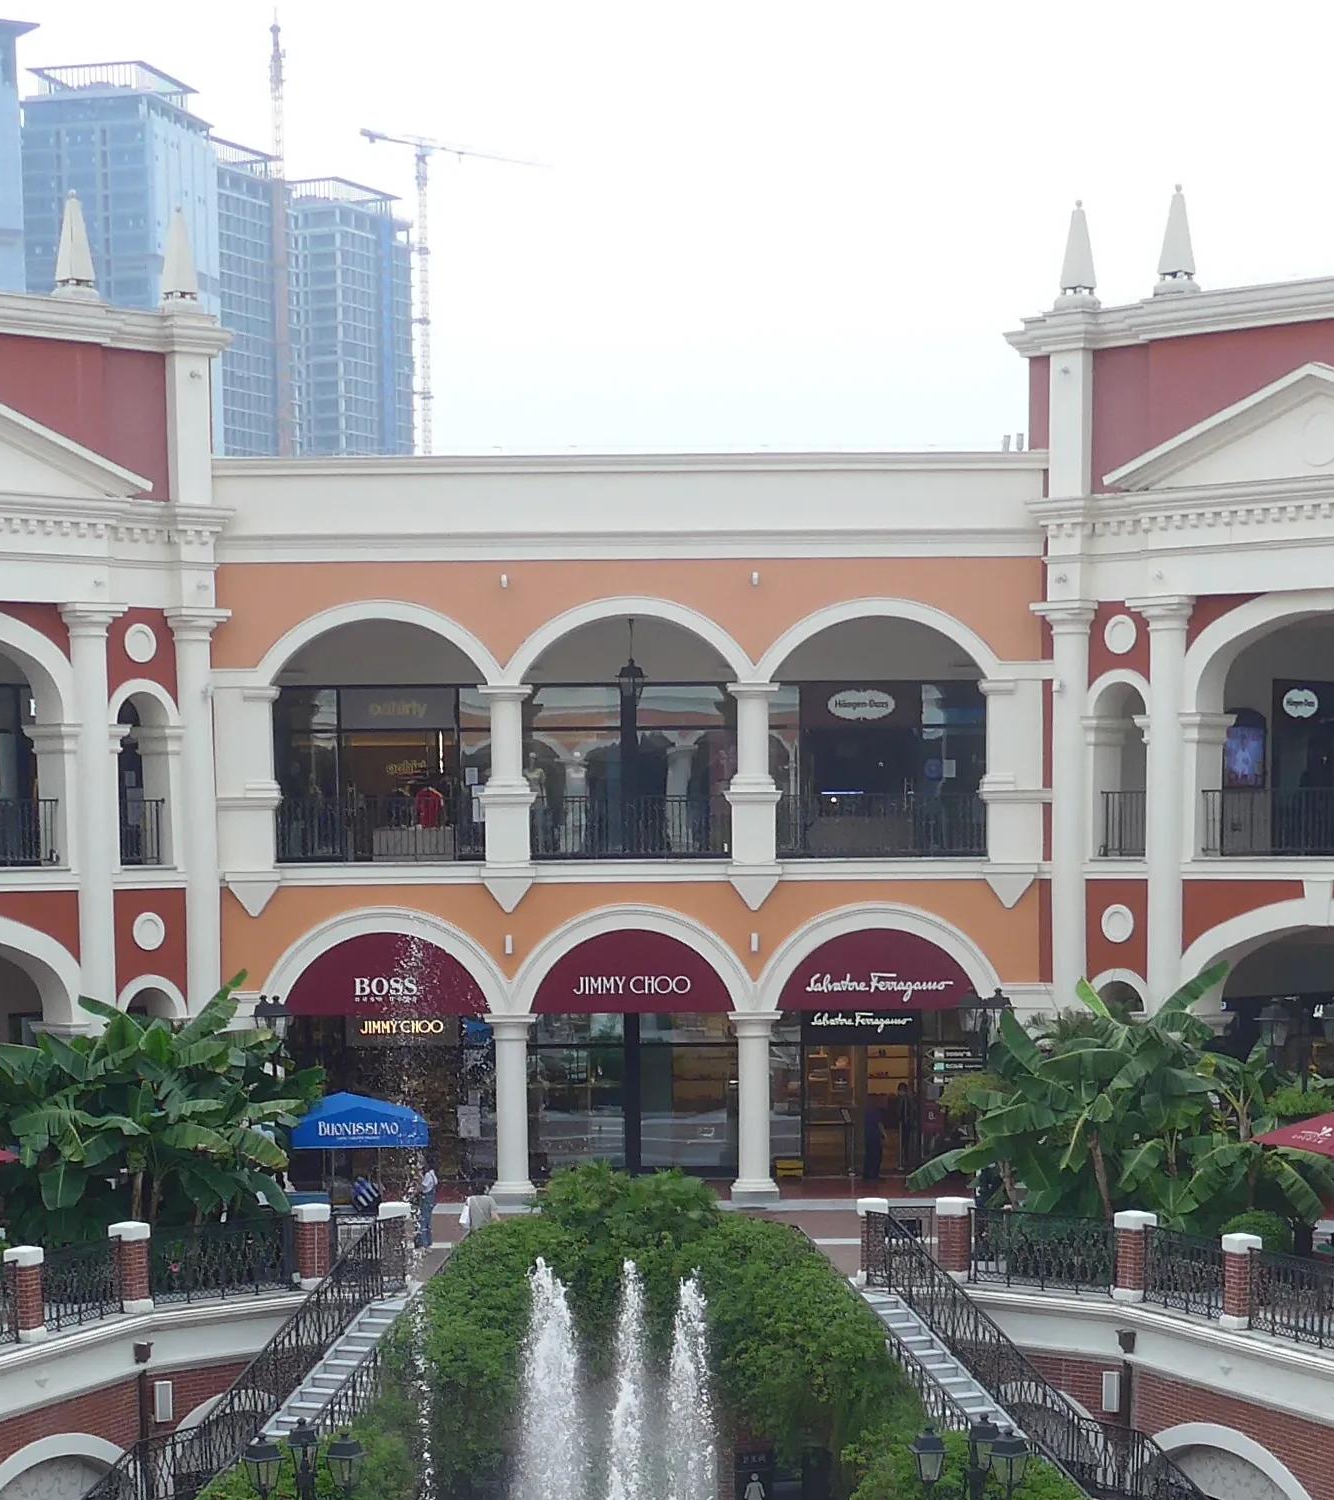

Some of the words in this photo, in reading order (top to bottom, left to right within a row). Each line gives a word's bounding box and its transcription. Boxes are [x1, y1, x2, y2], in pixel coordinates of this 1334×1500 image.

[354, 977, 419, 996] BOSS
[573, 976, 627, 995] JIMMY
[630, 975, 691, 995] CHOO
[805, 973, 869, 993] Salvatore
[870, 973, 954, 1002] Ferragamo
[360, 1020, 398, 1034] JIMMY
[399, 1020, 444, 1034] CHOO
